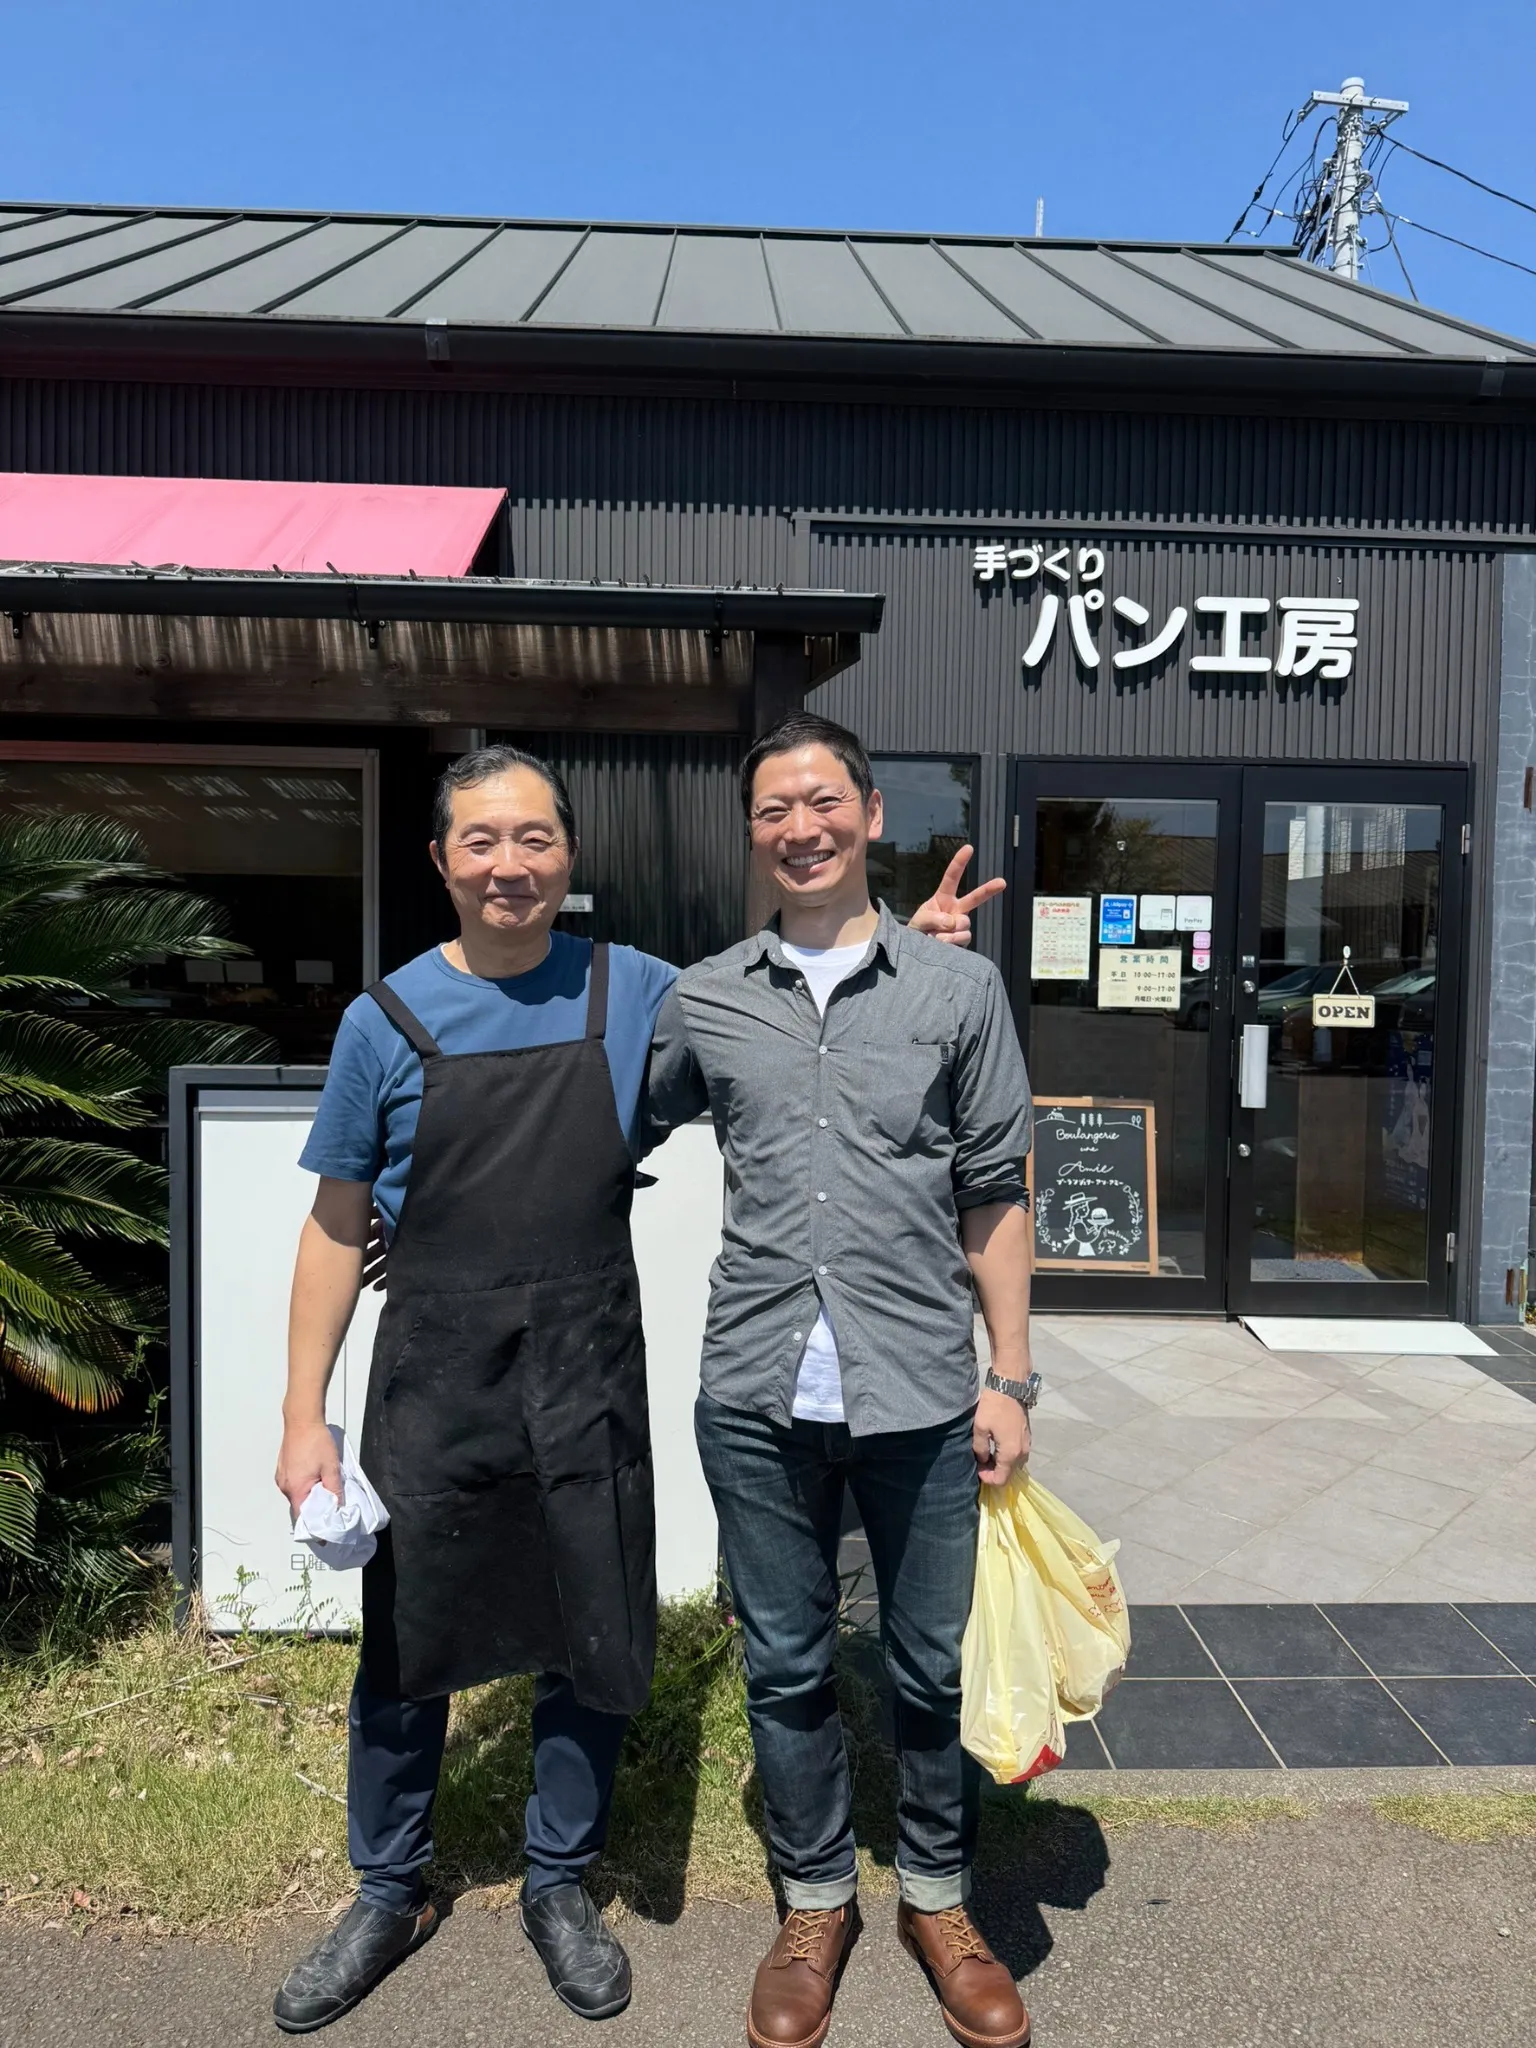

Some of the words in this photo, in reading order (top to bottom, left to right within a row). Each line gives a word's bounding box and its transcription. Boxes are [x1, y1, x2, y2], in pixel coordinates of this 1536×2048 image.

[973, 544, 1105, 581] 手づくり
[1021, 588, 1361, 679] パン工房
[1119, 955, 1169, 964] 営業時間
[1318, 1005, 1370, 1019] OPEN
[1056, 1127, 1120, 1144] Boulangerie
[1058, 1160, 1114, 1177] Amie
